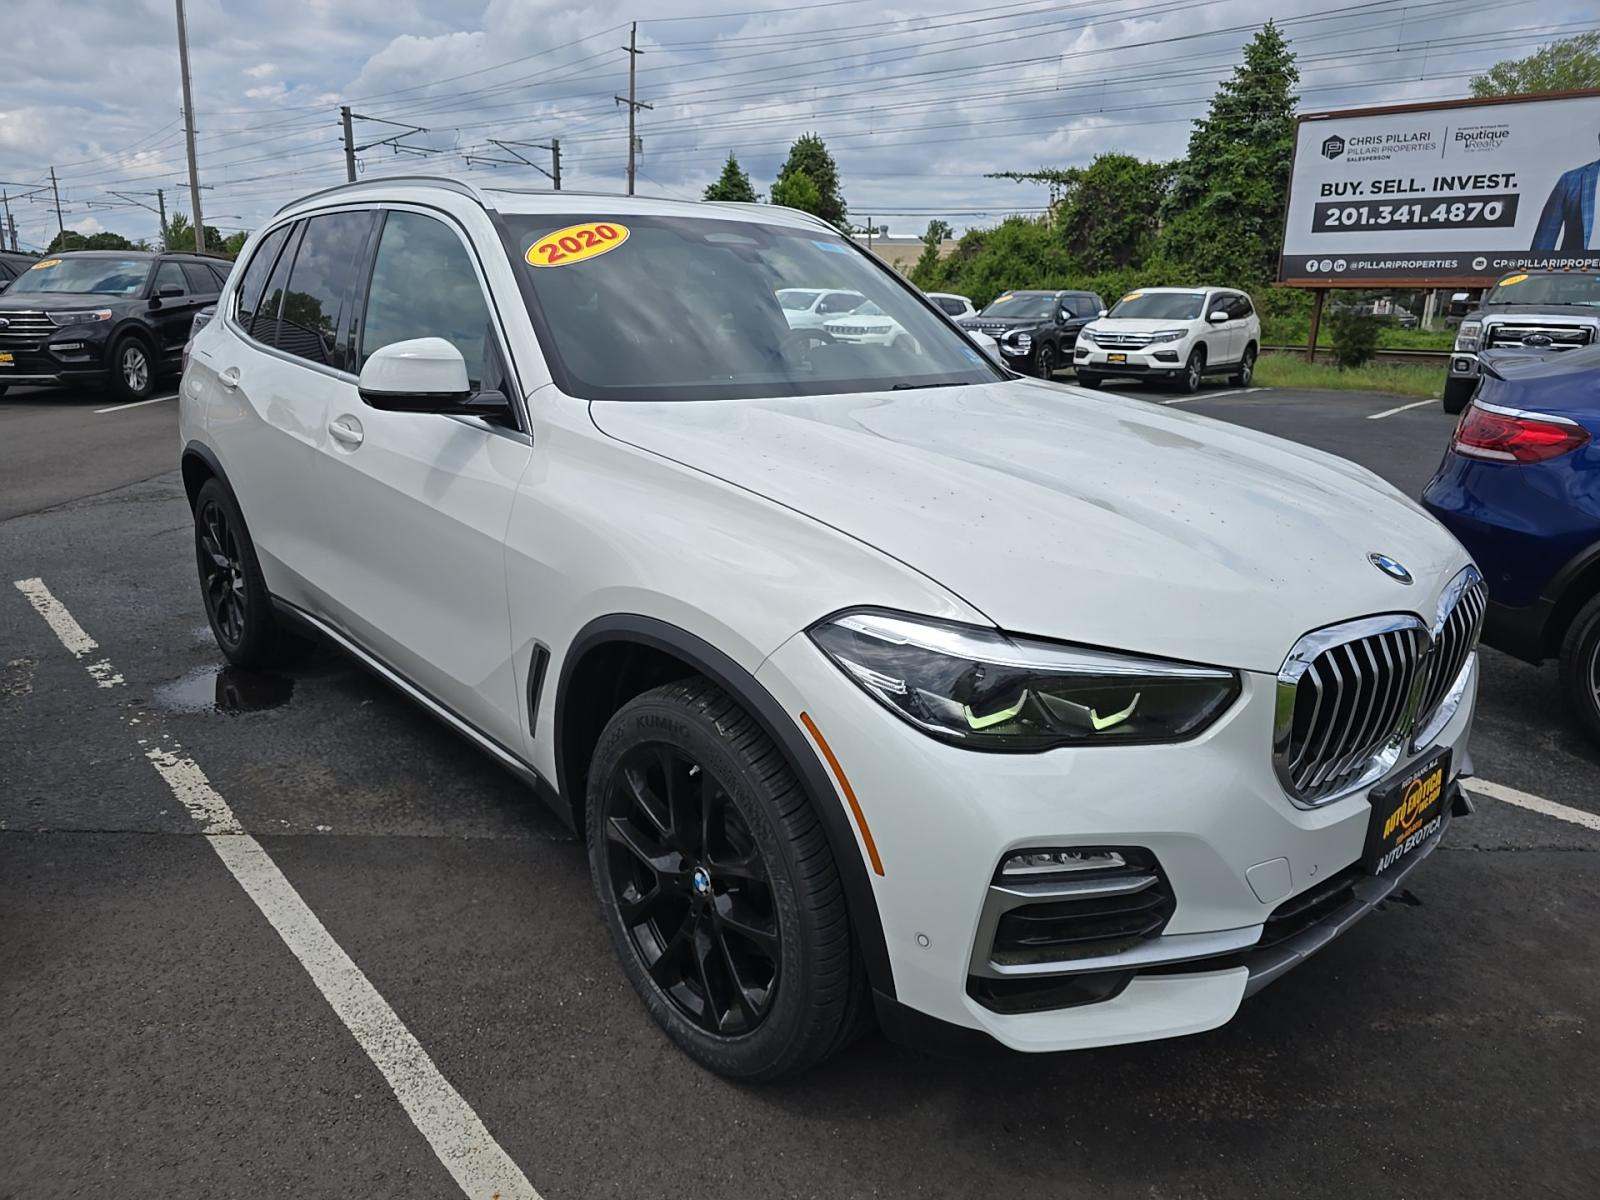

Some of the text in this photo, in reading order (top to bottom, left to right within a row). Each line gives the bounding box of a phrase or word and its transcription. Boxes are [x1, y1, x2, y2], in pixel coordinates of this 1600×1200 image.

[1348, 132, 1431, 146] CHRIS PILLARI
[1455, 130, 1510, 146] Boutique
[1468, 140, 1504, 150] Realty
[1347, 142, 1437, 156] PILLARI PROPERTIES
[1320, 173, 1518, 197] BUY. SELL. INVEST.
[1324, 201, 1504, 226] 201.341.4870
[538, 225, 619, 263] 2020
[1350, 259, 1458, 270] @PILLARIPROPERTIES
[1493, 258, 1600, 268] CP@PILLARIPROPE
[636, 714, 690, 738] KUMHO
[1383, 802, 1407, 840] AUTO
[1376, 844, 1403, 876] AUTO
[1404, 815, 1442, 854] EXOTICA
